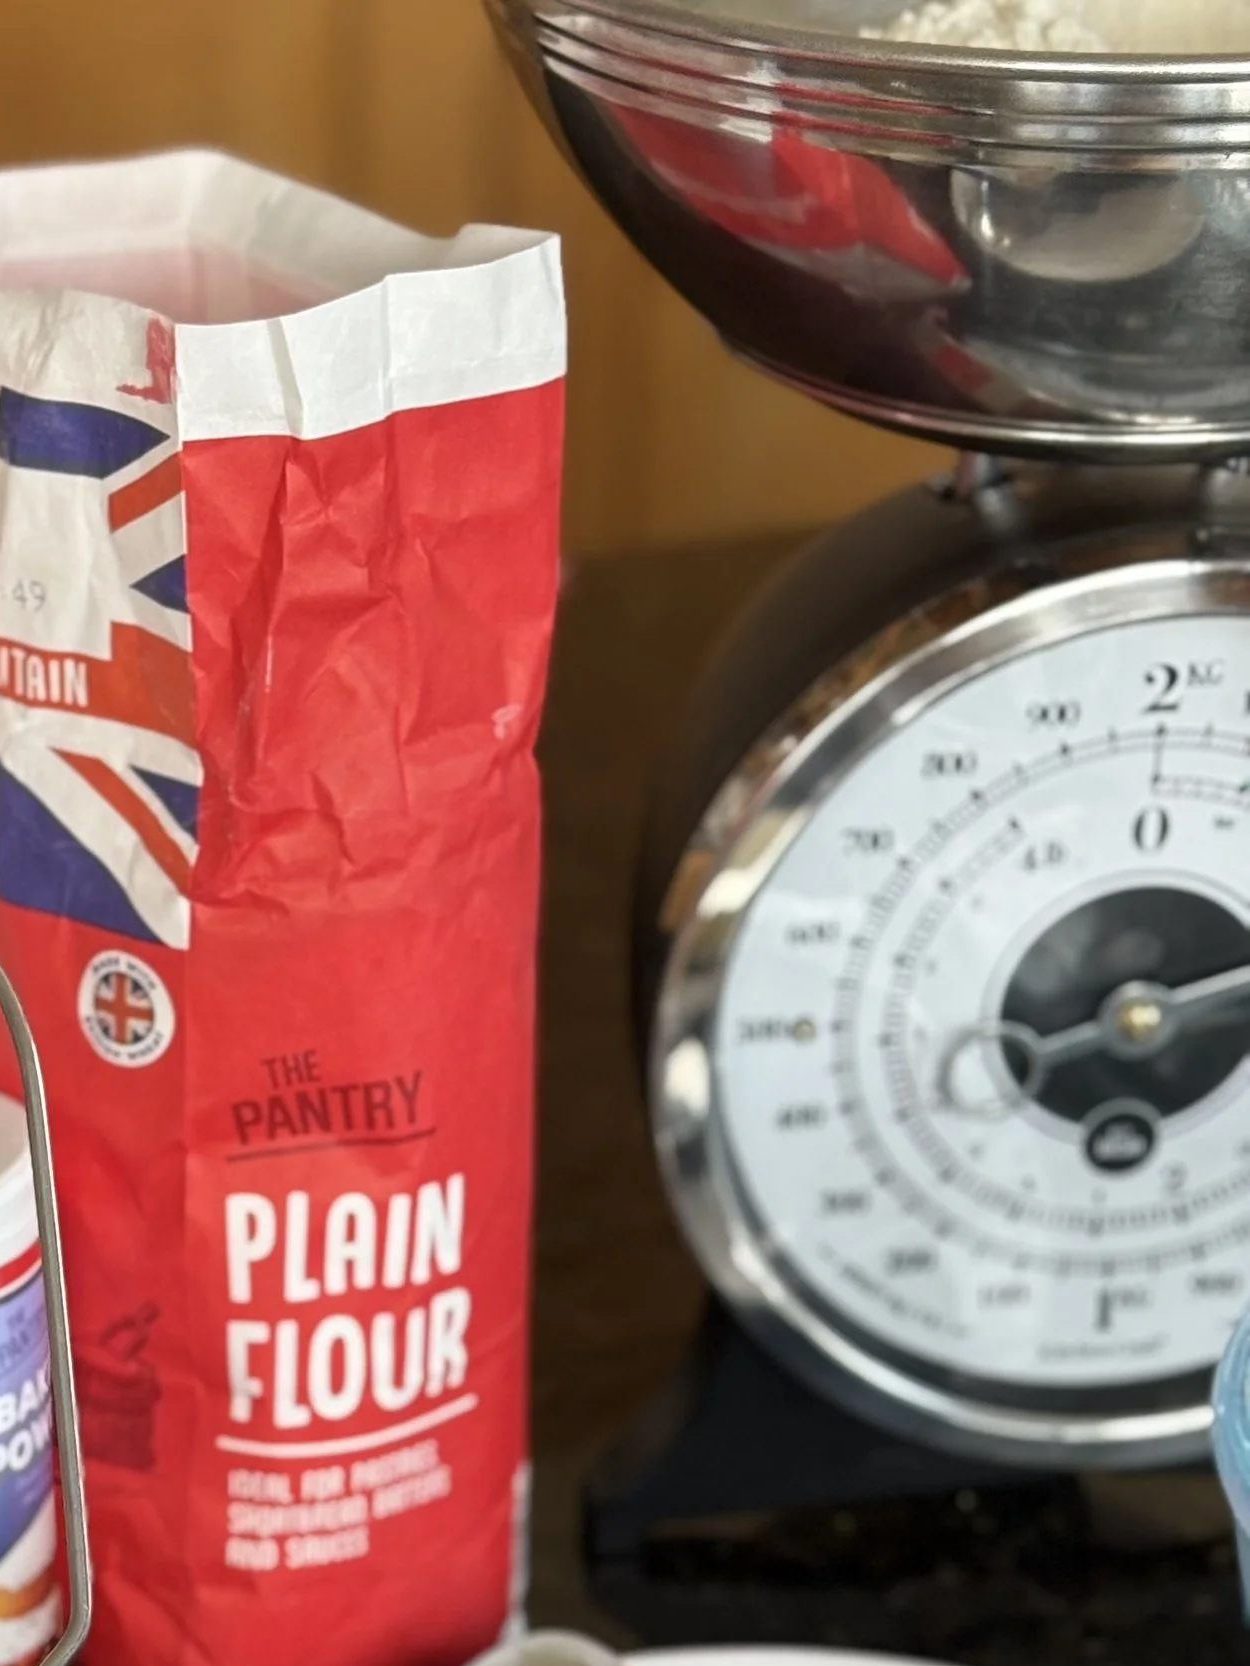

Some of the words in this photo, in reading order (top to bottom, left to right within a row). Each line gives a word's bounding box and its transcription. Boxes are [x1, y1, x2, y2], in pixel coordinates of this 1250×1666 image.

[1140, 661, 1181, 716] 2
[1132, 804, 1171, 852] 0
[262, 1049, 321, 1088] THE
[230, 1071, 425, 1146] PANTRY
[224, 1173, 465, 1304] PLAIN
[225, 1287, 472, 1429] FLOUR
